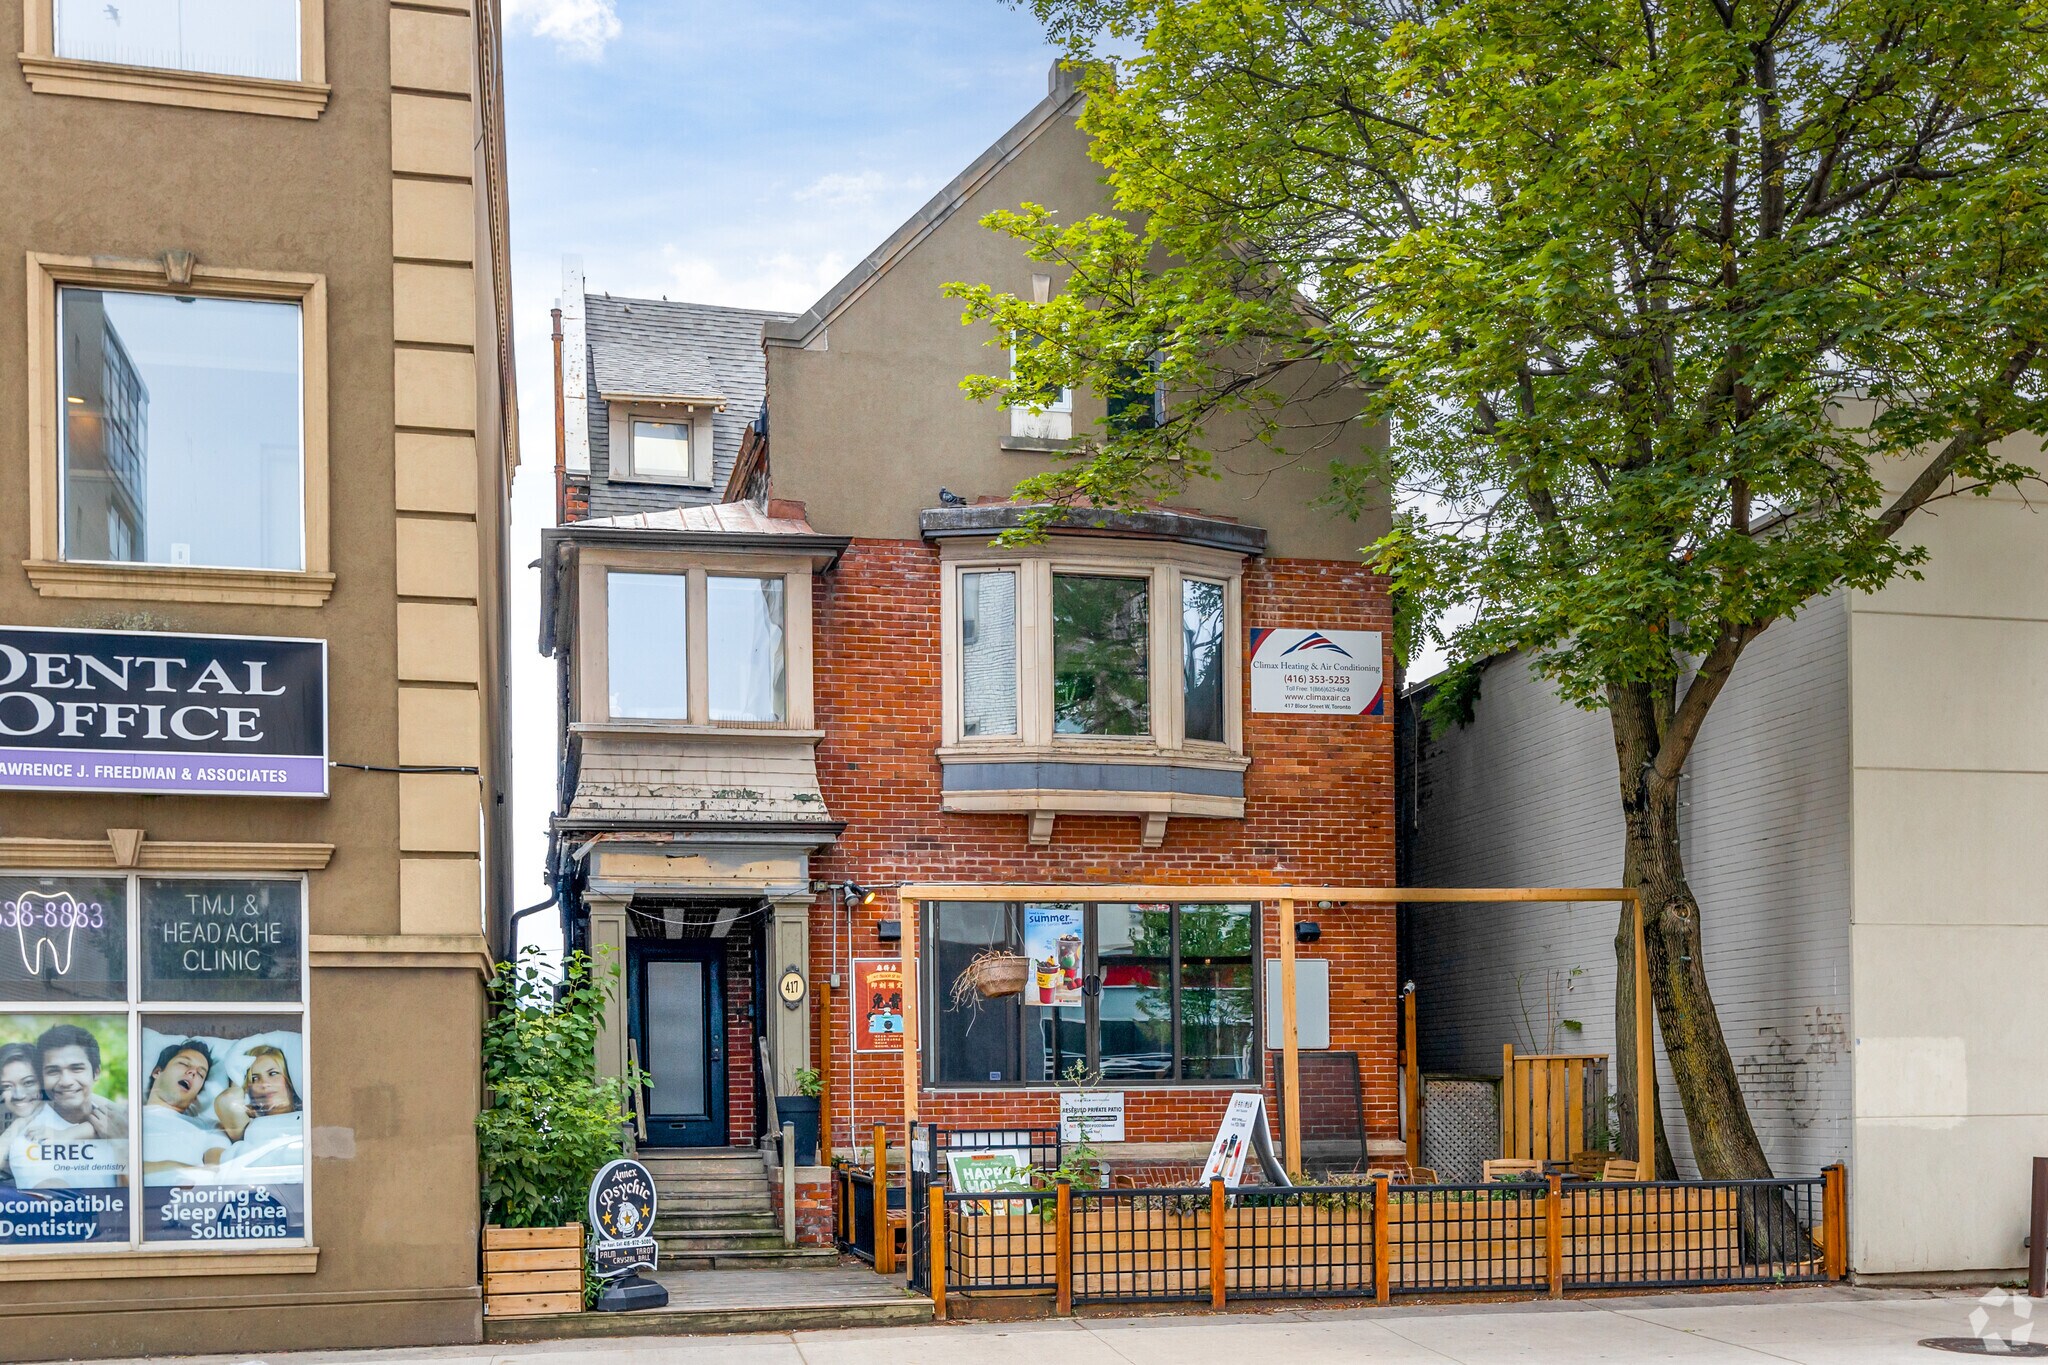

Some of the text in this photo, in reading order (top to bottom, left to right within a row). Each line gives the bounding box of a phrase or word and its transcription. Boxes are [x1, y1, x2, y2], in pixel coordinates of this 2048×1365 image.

[1253, 661, 1279, 669] Climax
[1280, 662, 1309, 671] Heating
[1320, 663, 1332, 671] Air
[1333, 663, 1380, 673] Conditioning
[1284, 674, 1350, 684] (416) 353-5253
[1284, 693, 1351, 701] www.climaxair.ca
[0, 691, 264, 742] OFFICE
[77, 765, 89, 779] J.
[94, 765, 176, 781] FREEDMAN
[181, 767, 192, 781] &
[196, 767, 287, 784] ASSOCIATES
[185, 894, 260, 916] TMJ &
[0, 901, 103, 928] 38-8883
[1029, 914, 1070, 923] summer
[163, 922, 282, 944] HEADACHE
[183, 949, 261, 971] CLINIC
[785, 980, 798, 993] 417
[26, 1144, 94, 1161] CEREC
[53, 1163, 126, 1172] One-visit dentistry
[612, 1169, 637, 1182] Annex
[963, 1167, 1011, 1179] HAPPY
[169, 1185, 271, 1207] Snoring &
[600, 1179, 650, 1212] Psychic
[161, 1202, 287, 1224] Sleep Apnea
[0, 1218, 97, 1240] Dentistry
[190, 1221, 287, 1239] Solutions
[600, 1247, 654, 1259] PALM TAROT
[612, 1254, 651, 1265] CRYSTAL BALL
